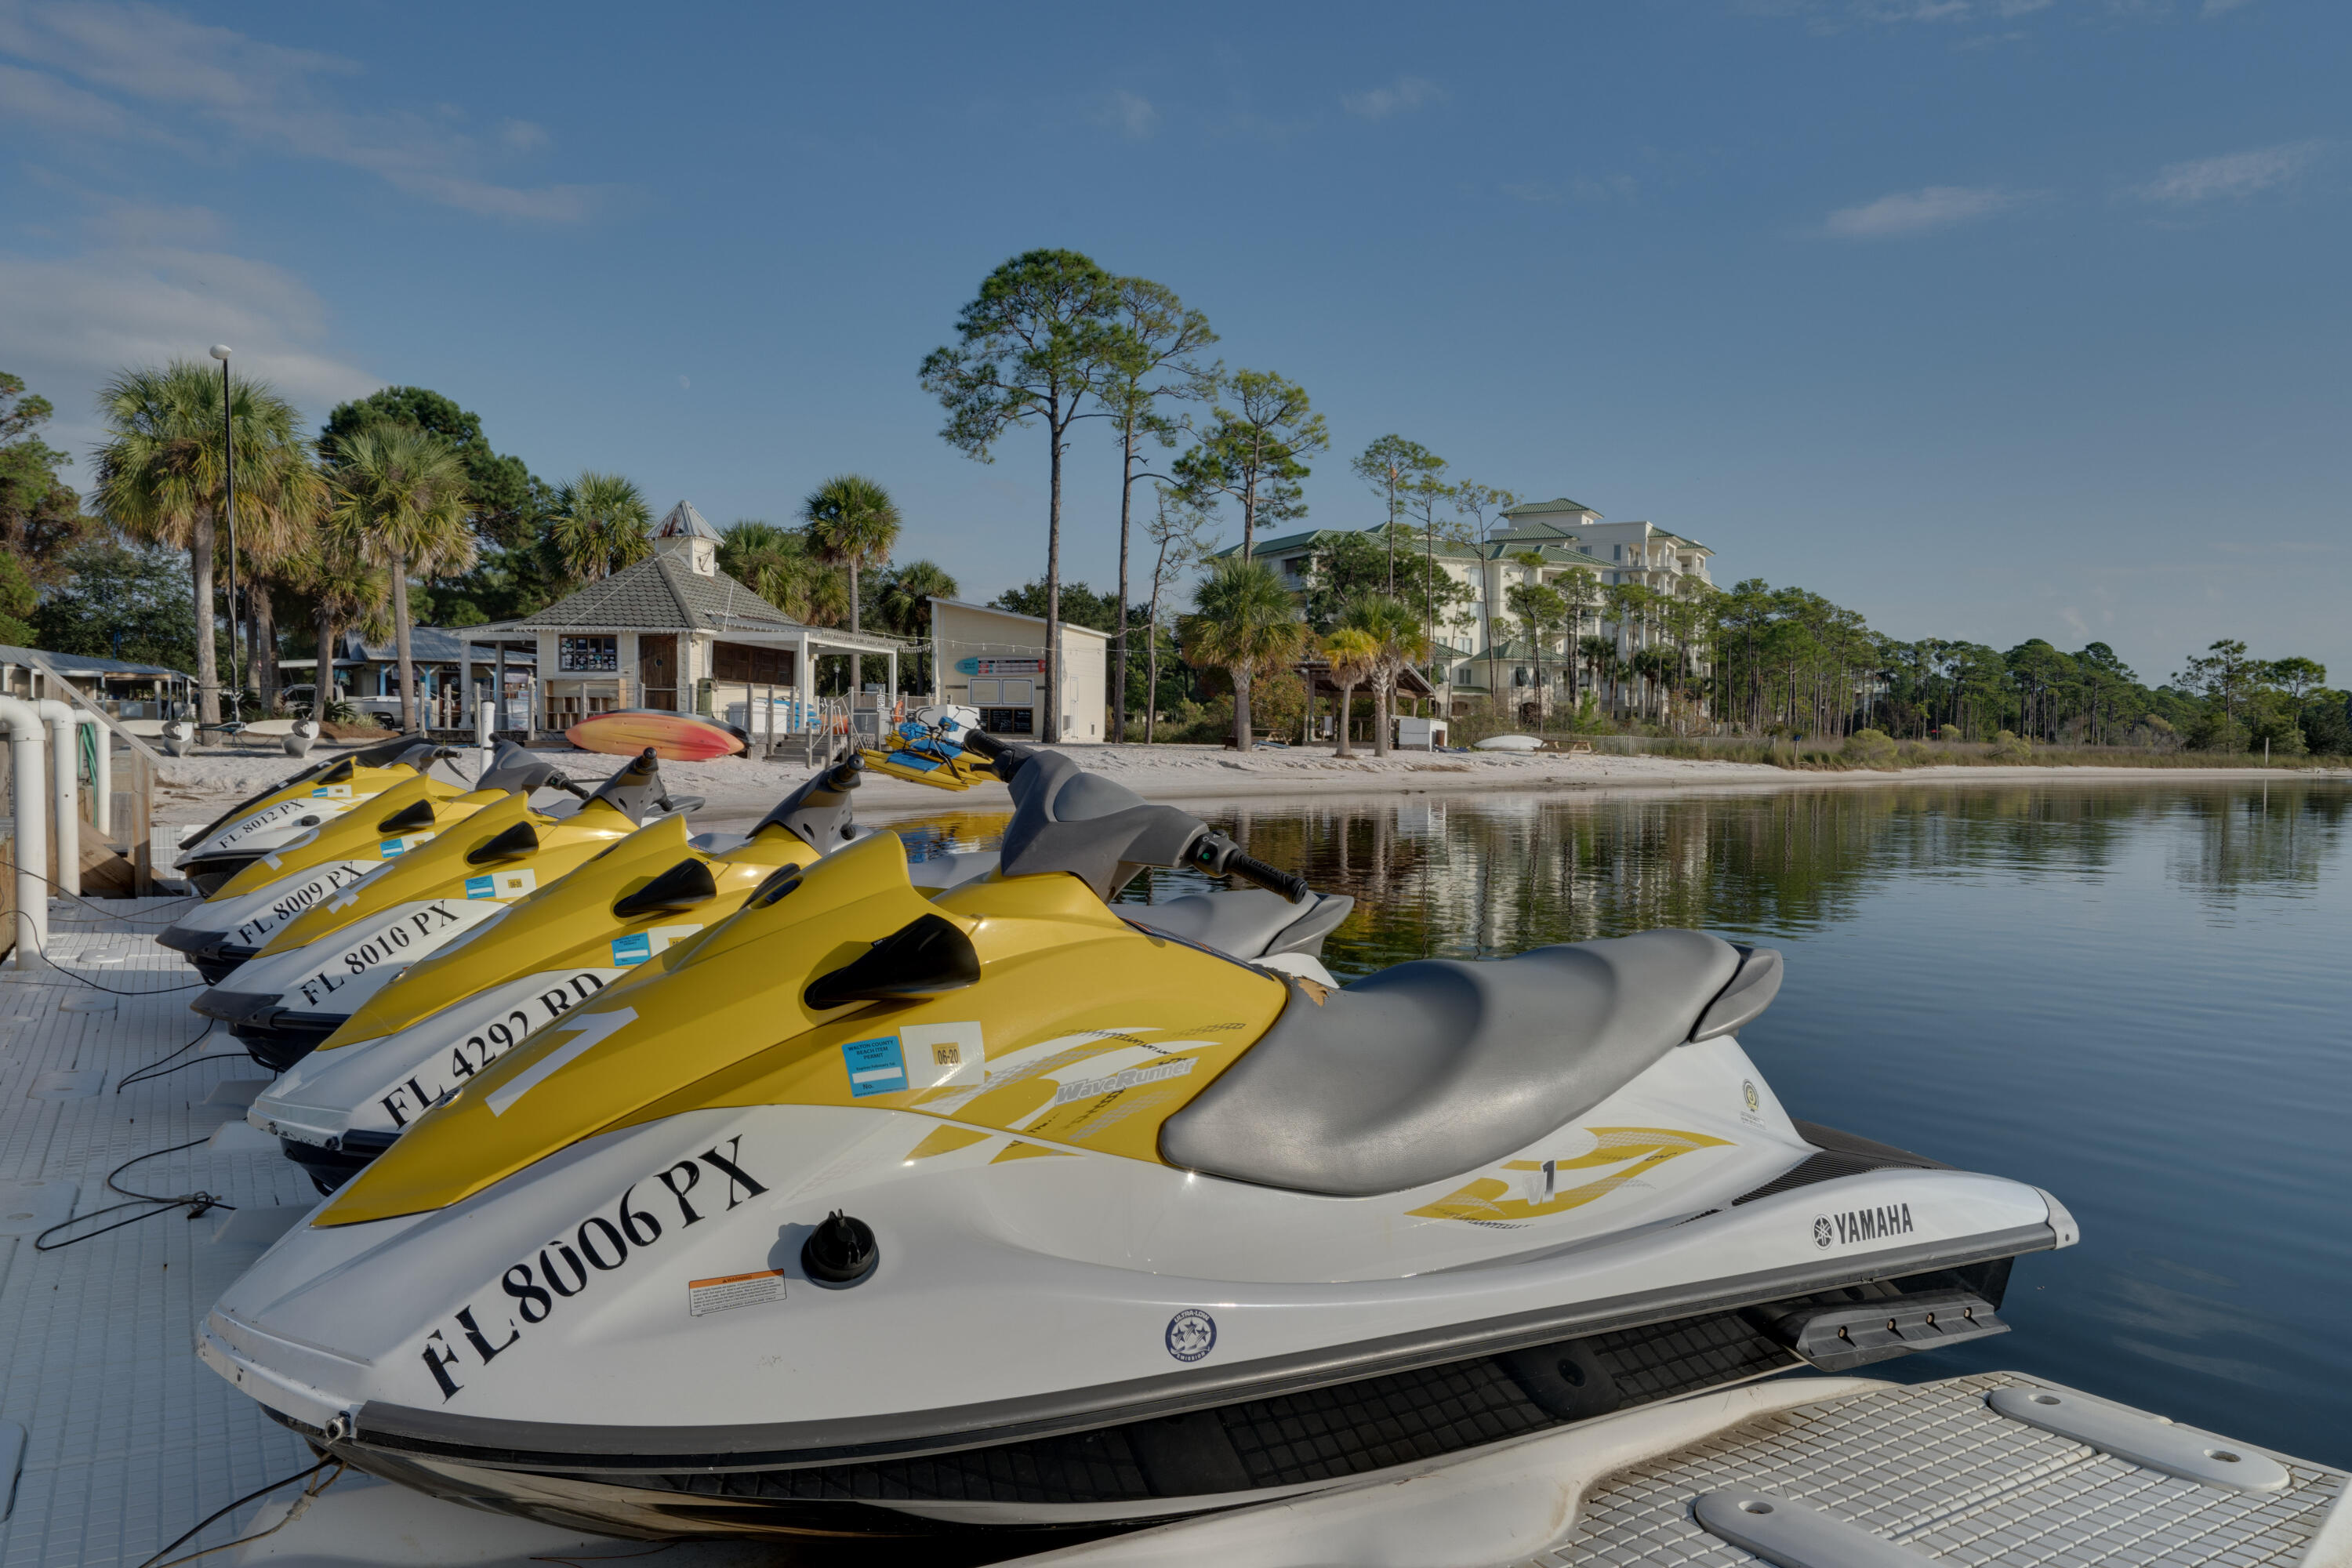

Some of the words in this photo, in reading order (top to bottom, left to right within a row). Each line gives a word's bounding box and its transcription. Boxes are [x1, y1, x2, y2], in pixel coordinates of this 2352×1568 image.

[220, 833, 242, 849] FL
[242, 811, 278, 833] 8012
[280, 798, 305, 815] PX
[238, 917, 274, 946] FL
[273, 882, 324, 920] 8009
[326, 861, 364, 890] PX
[299, 970, 345, 1007] FL
[344, 927, 410, 975] 8010
[409, 898, 460, 938] PX
[848, 1043, 871, 1051] WALTON
[938, 1048, 959, 1065] 06-20
[377, 1075, 445, 1131] FL
[1056, 1057, 1200, 1106] WaveRunner
[1834, 1203, 1914, 1244] YAMAHA
